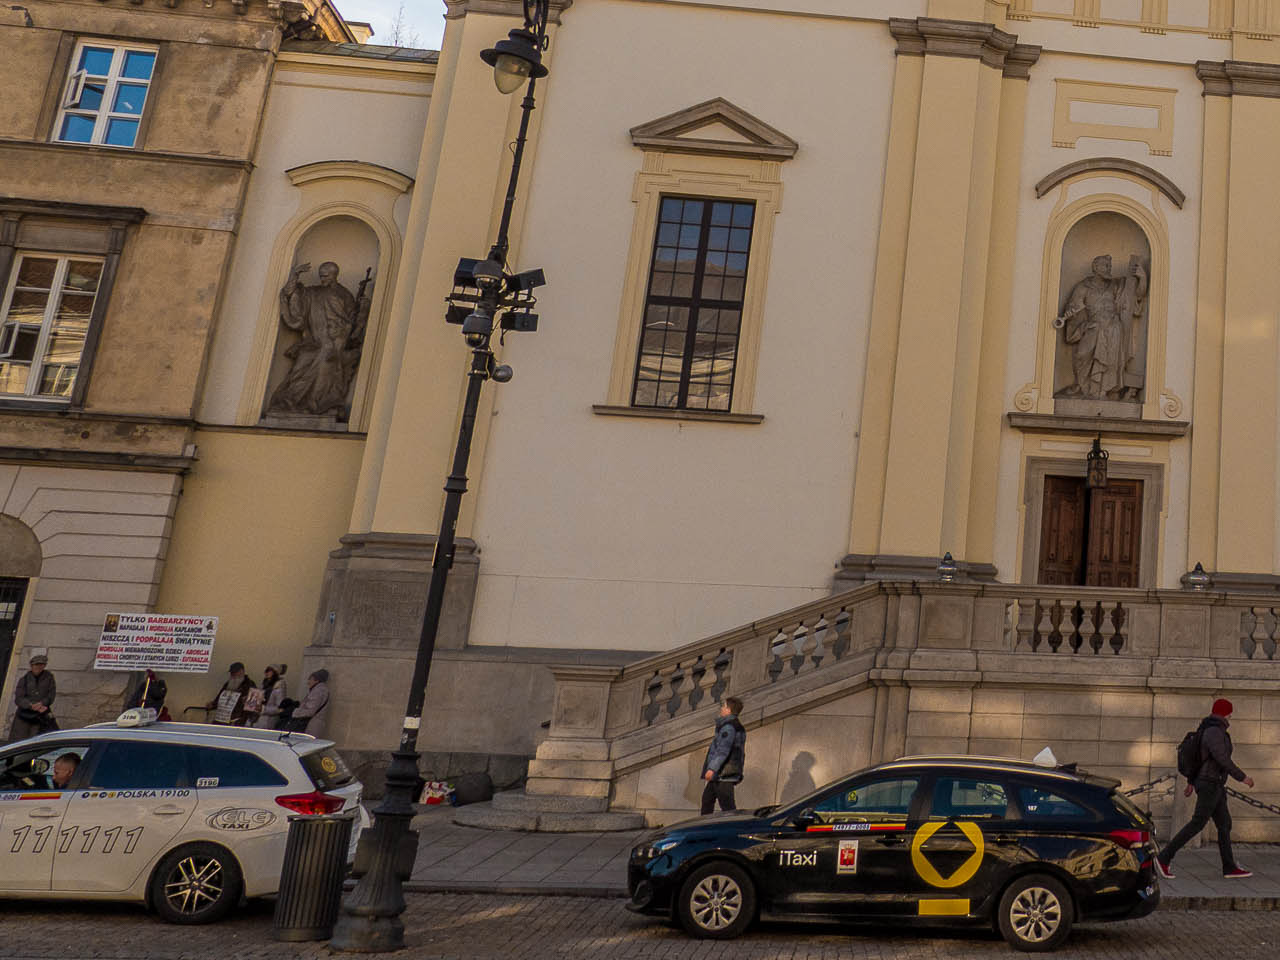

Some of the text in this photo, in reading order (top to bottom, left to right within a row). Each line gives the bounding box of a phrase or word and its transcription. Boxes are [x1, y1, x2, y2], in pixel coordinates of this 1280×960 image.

[116, 789, 190, 798] POLSKA 19100
[779, 850, 817, 866] iTaxi
